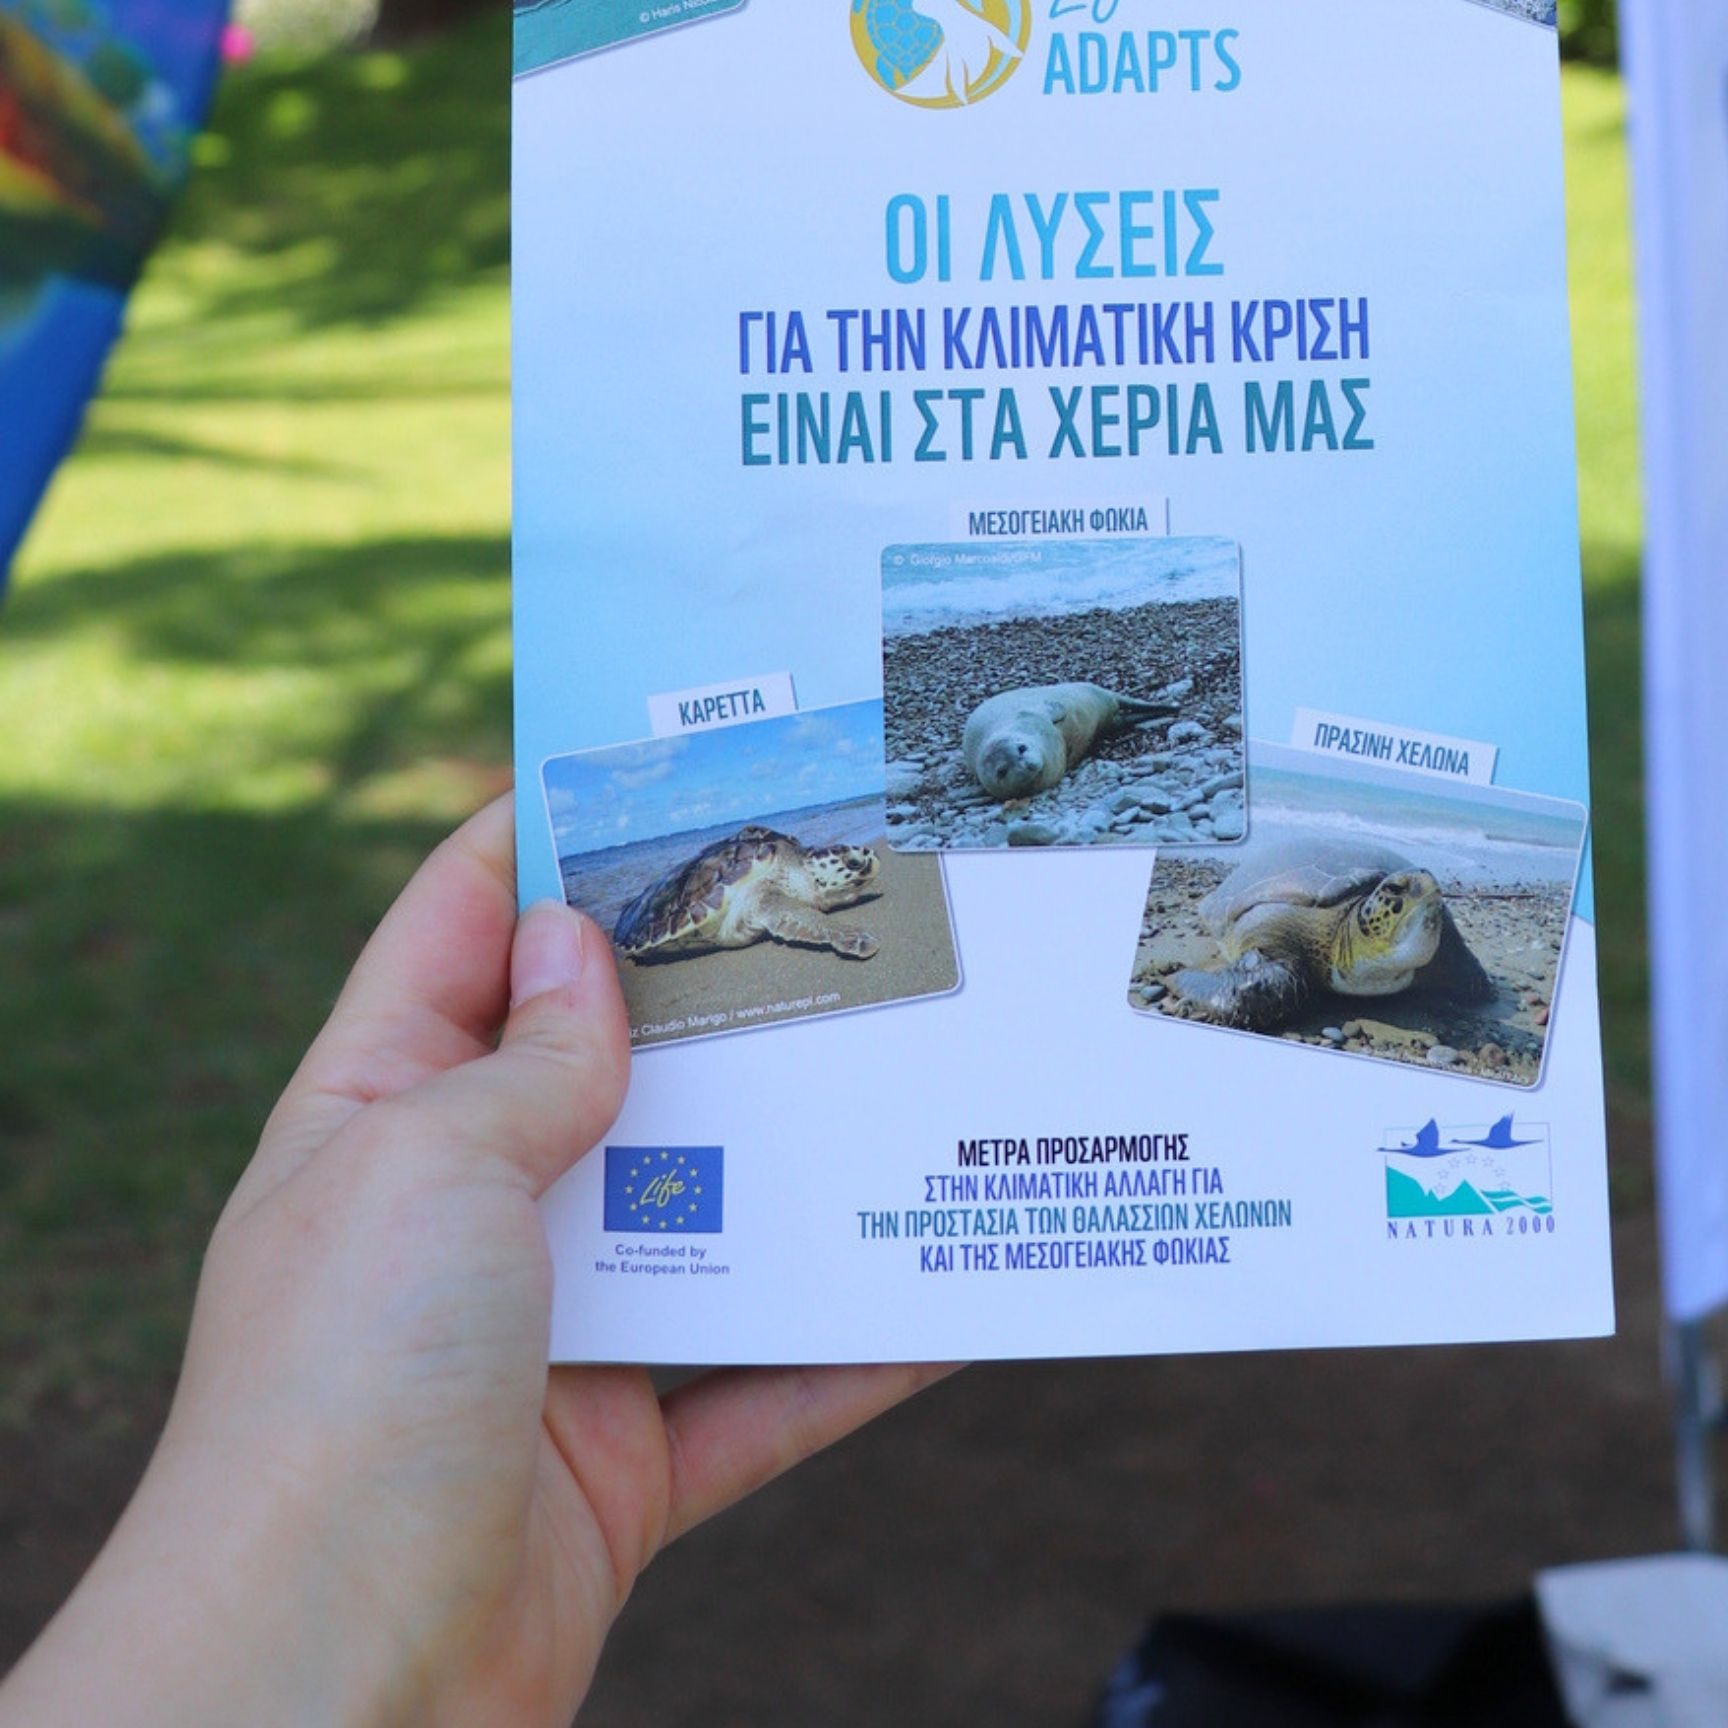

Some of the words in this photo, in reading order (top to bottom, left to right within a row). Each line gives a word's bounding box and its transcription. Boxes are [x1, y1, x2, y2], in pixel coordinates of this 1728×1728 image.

[1043, 28, 1242, 96] ADAPTS
[884, 191, 952, 285] ΟΙ
[980, 188, 1226, 283] ΛΥΣΕΙΣ
[738, 308, 814, 377] ΓΙΑ
[826, 308, 927, 375] ΤΗΝ
[942, 300, 1216, 372] ΚΛΙΜΑΤΙΚΗ
[1231, 296, 1371, 364] ΚΡΙΣΗ
[740, 390, 895, 467] ΕΙΝΑΙ
[913, 386, 1027, 464] ΣΤΑ
[1048, 382, 1221, 462] ΧΕΡΙΑ
[1245, 377, 1375, 455] ΜΑΣ
[969, 509, 1084, 536] ΜΕΣΟΓΕΙΑΚΗ
[1089, 507, 1148, 532] ΦΩΚΙΑ
[678, 688, 766, 727] ΚΑΡΕΤΤΑ
[1313, 722, 1395, 761] ΠΡΑΣΙΝΗ
[1395, 738, 1470, 777] ΧΕΛΩΝΑ
[958, 1140, 1030, 1167] ΜΕΤΡΑ
[1036, 1134, 1190, 1164] ΠΡΟΣΑΡΜΟΓΗΣ
[640, 1169, 685, 1207] Life
[924, 1175, 979, 1202] ΣΤΗΝ
[984, 1172, 1098, 1201] ΚΛΙΜΑΤΙΚΗ
[1104, 1170, 1187, 1197] ΑΛΛΑΓΗ
[1192, 1167, 1224, 1194] ΓΙΑ
[857, 1211, 898, 1239] ΤΗΝ
[905, 1208, 1019, 1237] ΠΡΟΣΤΑΣΙΑ
[1024, 1206, 1067, 1234] ΤΩΝ
[1073, 1202, 1189, 1233] ΘΑΛΑΣΣΙΩΝ
[1194, 1199, 1292, 1229] ΧΕΛΩΝΩΝ
[1387, 1218, 1493, 1239] NATURA
[1506, 1214, 1556, 1235] 2000
[596, 1261, 616, 1273] the
[621, 1263, 685, 1276] European
[690, 1264, 730, 1275] Union
[615, 1244, 686, 1257] Co-funded
[690, 1246, 706, 1261] by
[920, 1245, 953, 1272] ΚΑΙ
[960, 1243, 1000, 1271] ΤΗΣ
[1005, 1239, 1147, 1270] ΜΕΣΟΓΕΙΑΚΗΣ
[1153, 1236, 1231, 1265] ΦΩΚΙΑΣ
